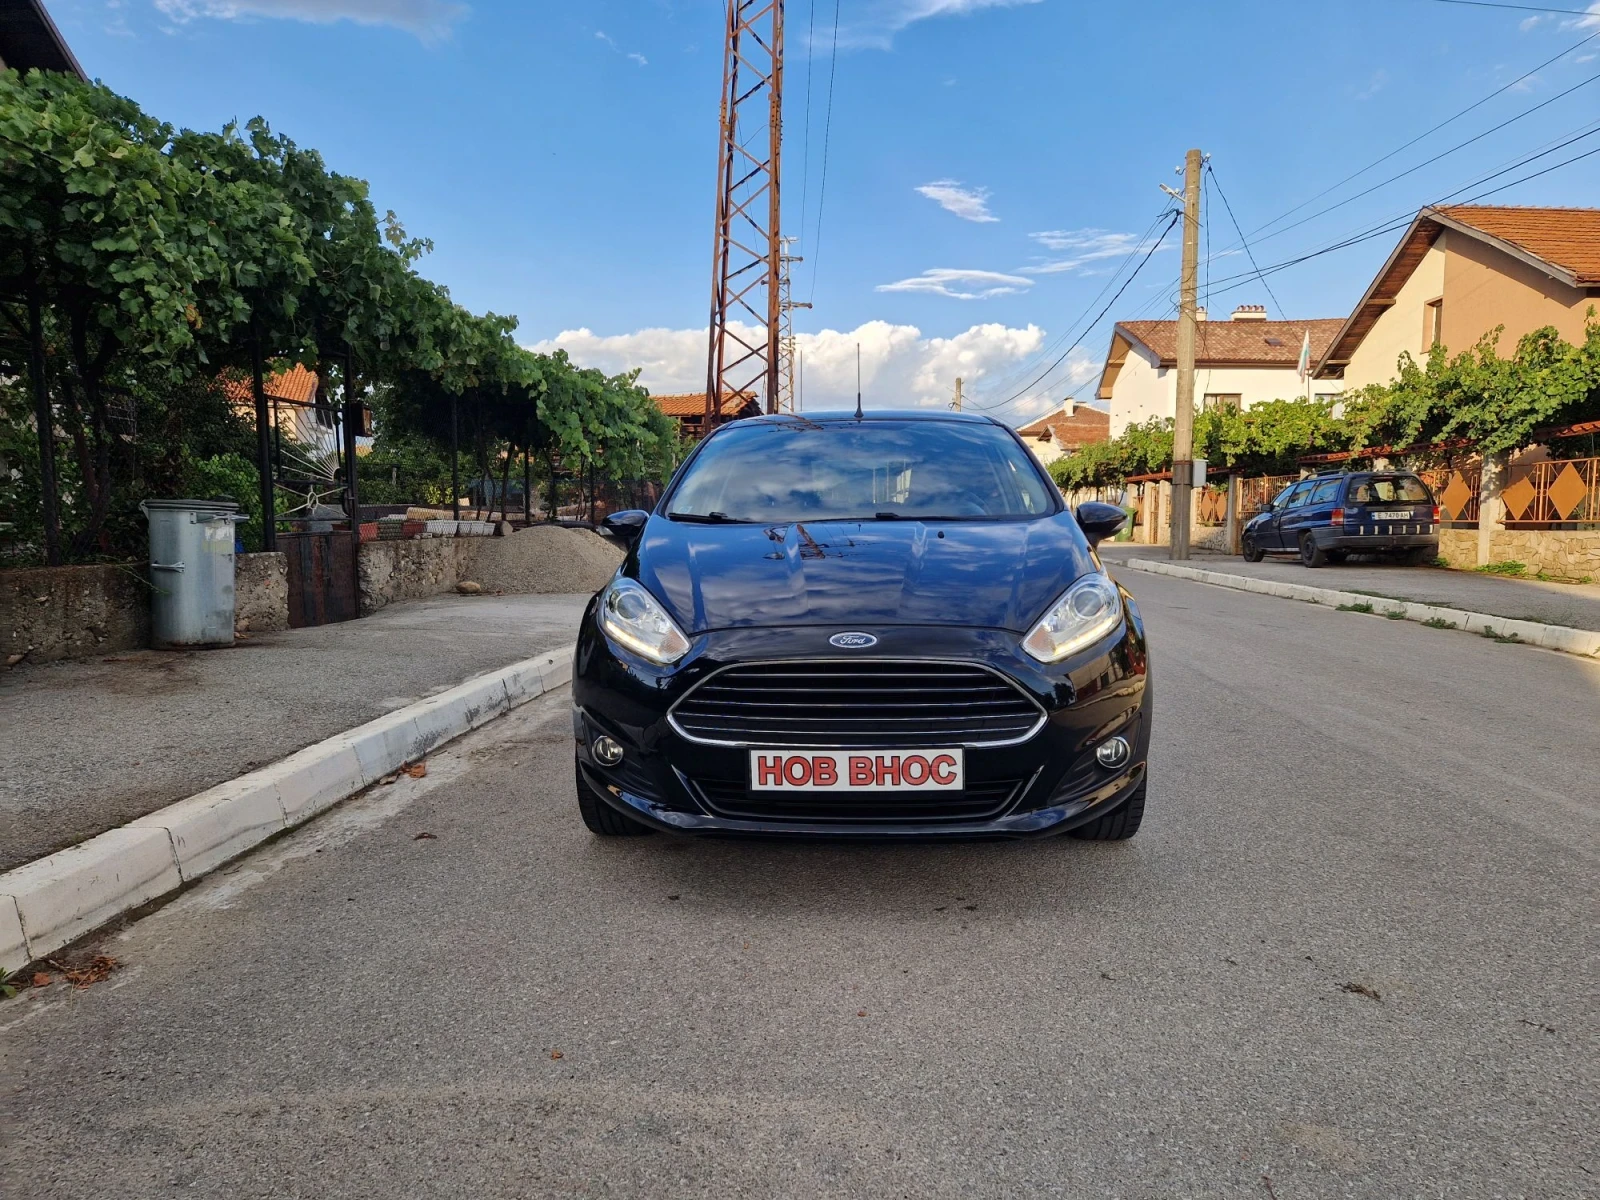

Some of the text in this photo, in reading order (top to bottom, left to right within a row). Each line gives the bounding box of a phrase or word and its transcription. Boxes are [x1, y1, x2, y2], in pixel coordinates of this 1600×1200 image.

[839, 635, 866, 644] Ford
[757, 754, 957, 786] НОВ ВНОС
